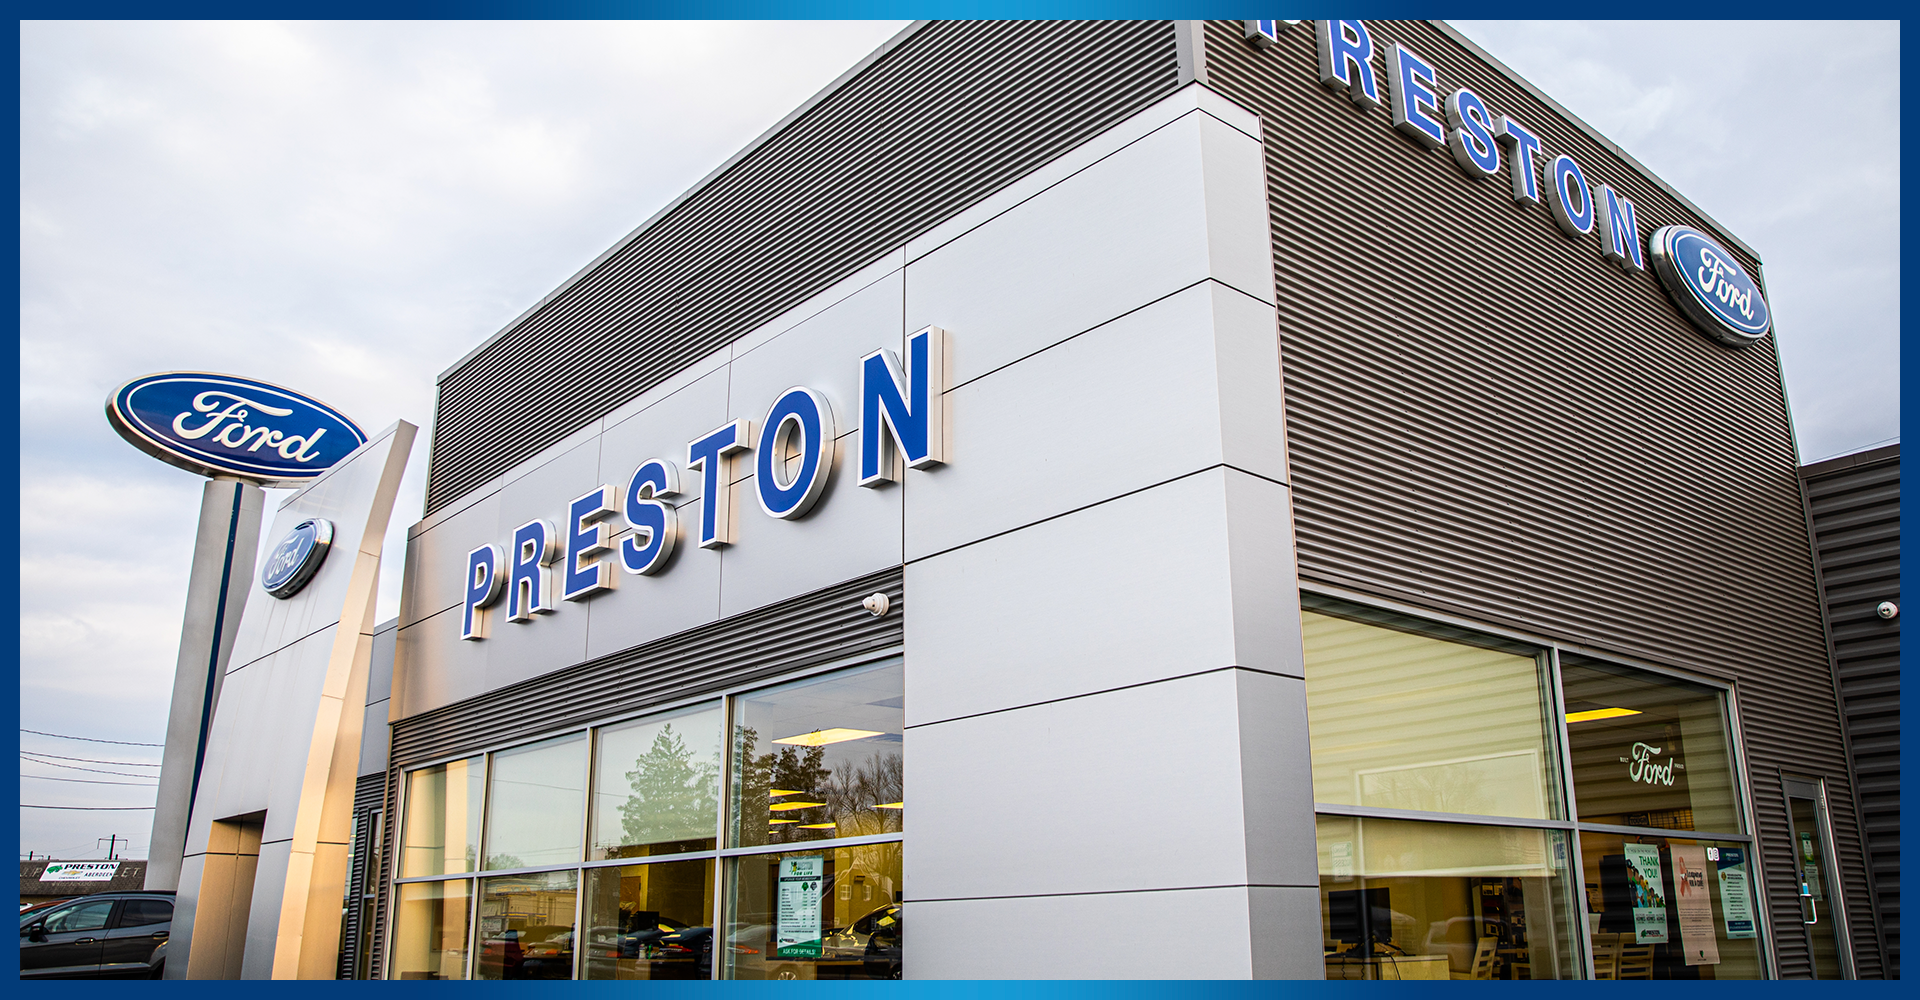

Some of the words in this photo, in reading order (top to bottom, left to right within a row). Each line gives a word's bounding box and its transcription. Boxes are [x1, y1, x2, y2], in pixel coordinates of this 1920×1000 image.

[1245, 20, 1644, 274] RESTON
[1698, 247, 1755, 321] Ford
[172, 390, 327, 463] Ford
[461, 325, 944, 640] PRESTON
[268, 534, 304, 580] Ford
[1629, 742, 1675, 786] Ford
[1639, 855, 1659, 866] THANK
[1643, 868, 1658, 879] YOU!
